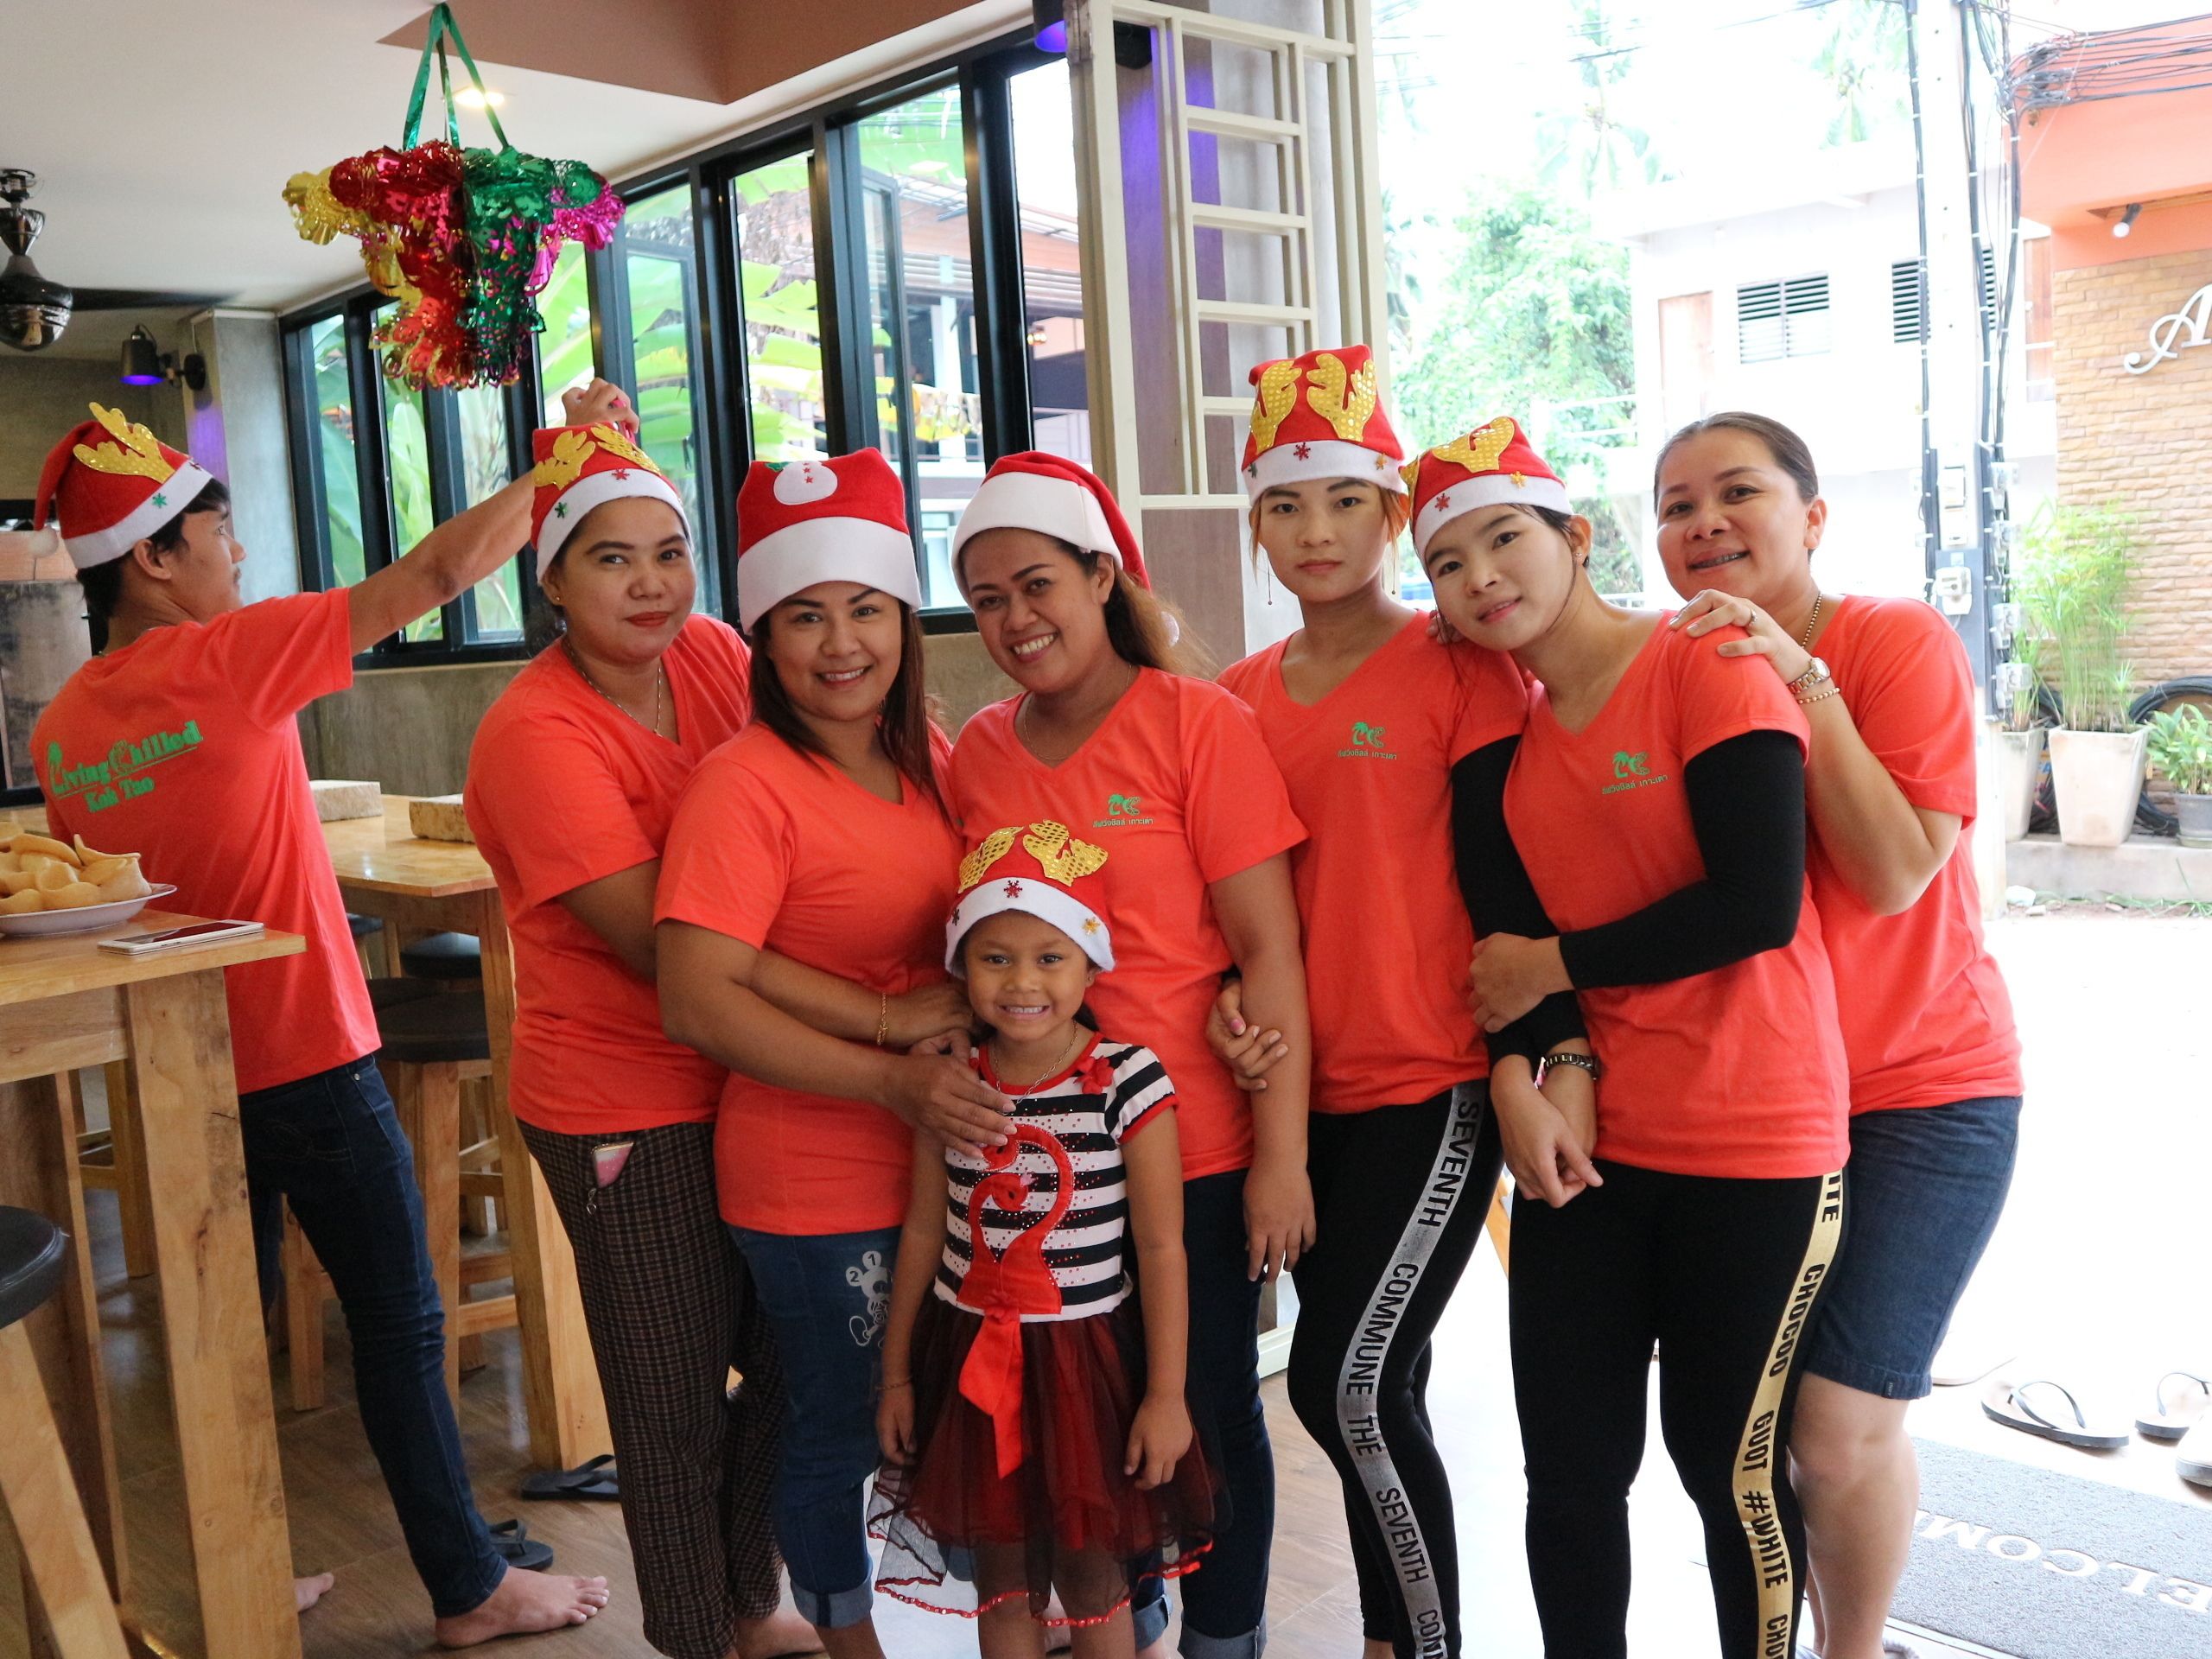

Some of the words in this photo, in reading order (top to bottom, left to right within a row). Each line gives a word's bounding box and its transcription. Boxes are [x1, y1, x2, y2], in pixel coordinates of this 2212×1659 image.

[109, 719, 204, 776] Chilled
[1416, 1099, 1481, 1228] SEVENTH
[1345, 1262, 1419, 1396] COMMUNE
[1346, 1414, 1382, 1457] THE
[1376, 1486, 1430, 1584] SEVENTH
[1742, 1490, 1789, 1589] #WHITE
[1913, 1509, 2212, 1615] ELCOM
[1764, 1613, 1789, 1659] CHO
